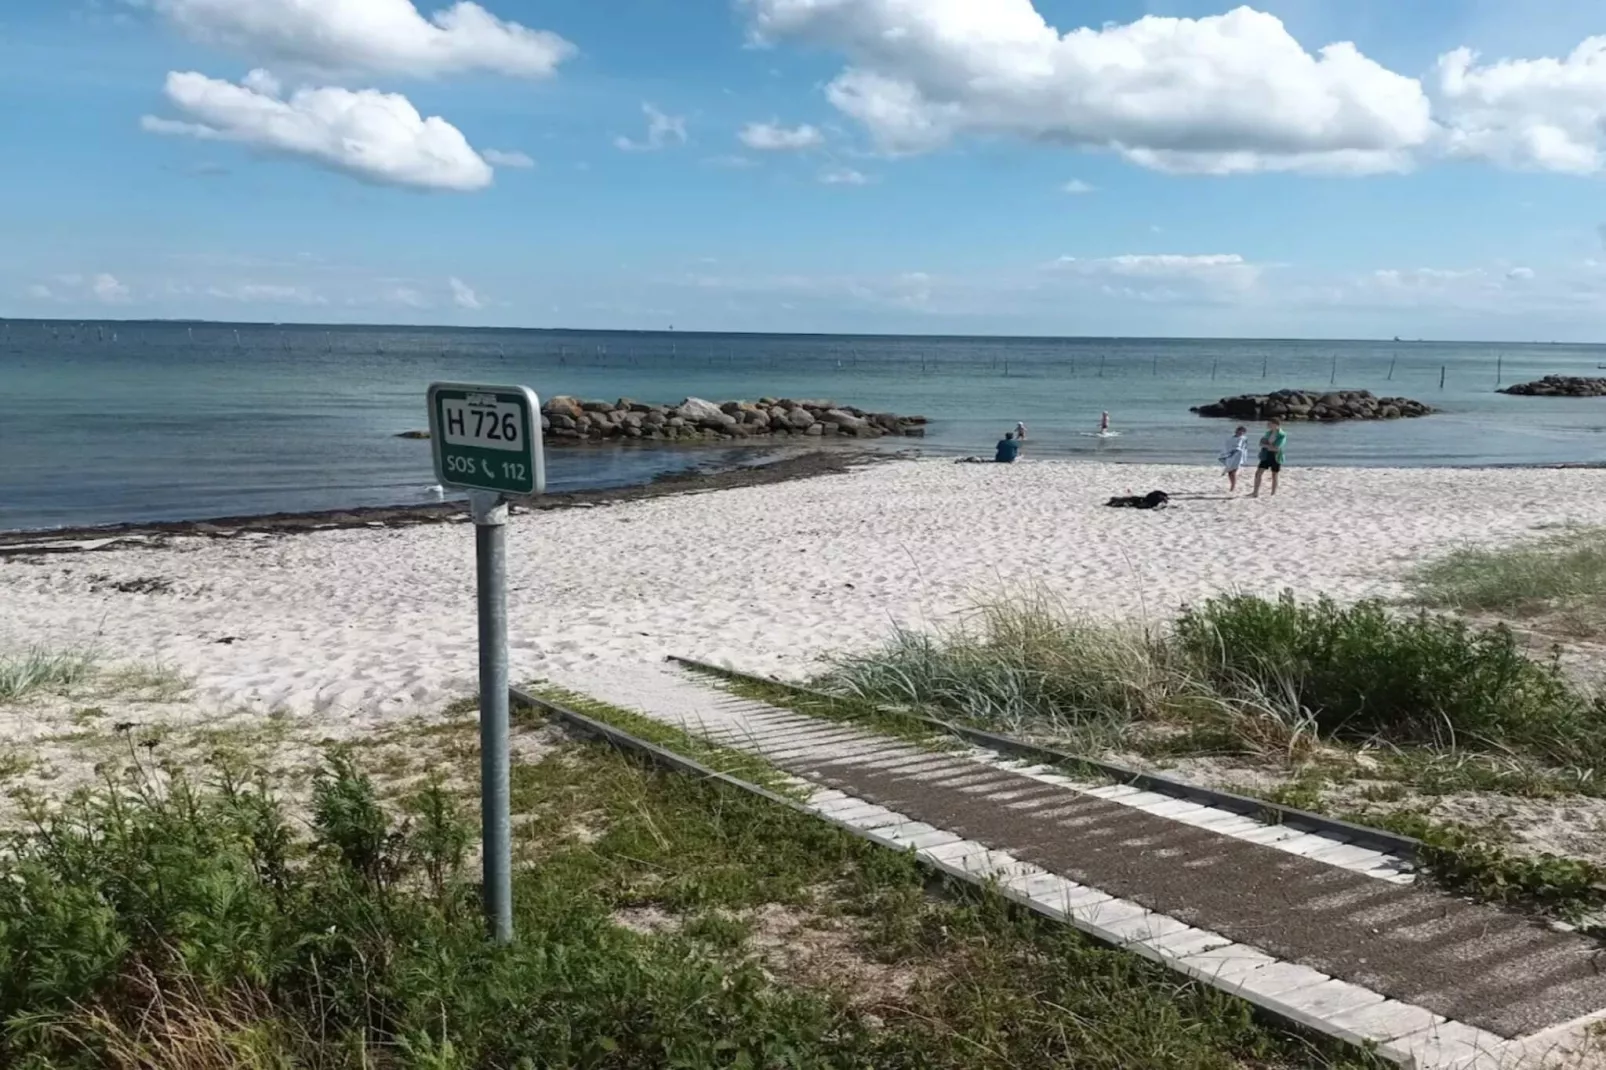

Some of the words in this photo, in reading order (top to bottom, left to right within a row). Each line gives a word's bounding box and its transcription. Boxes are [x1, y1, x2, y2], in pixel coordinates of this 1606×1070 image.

[447, 408, 465, 436] H
[471, 410, 517, 442] 726
[447, 455, 476, 474] SOS
[502, 462, 526, 480] 112
